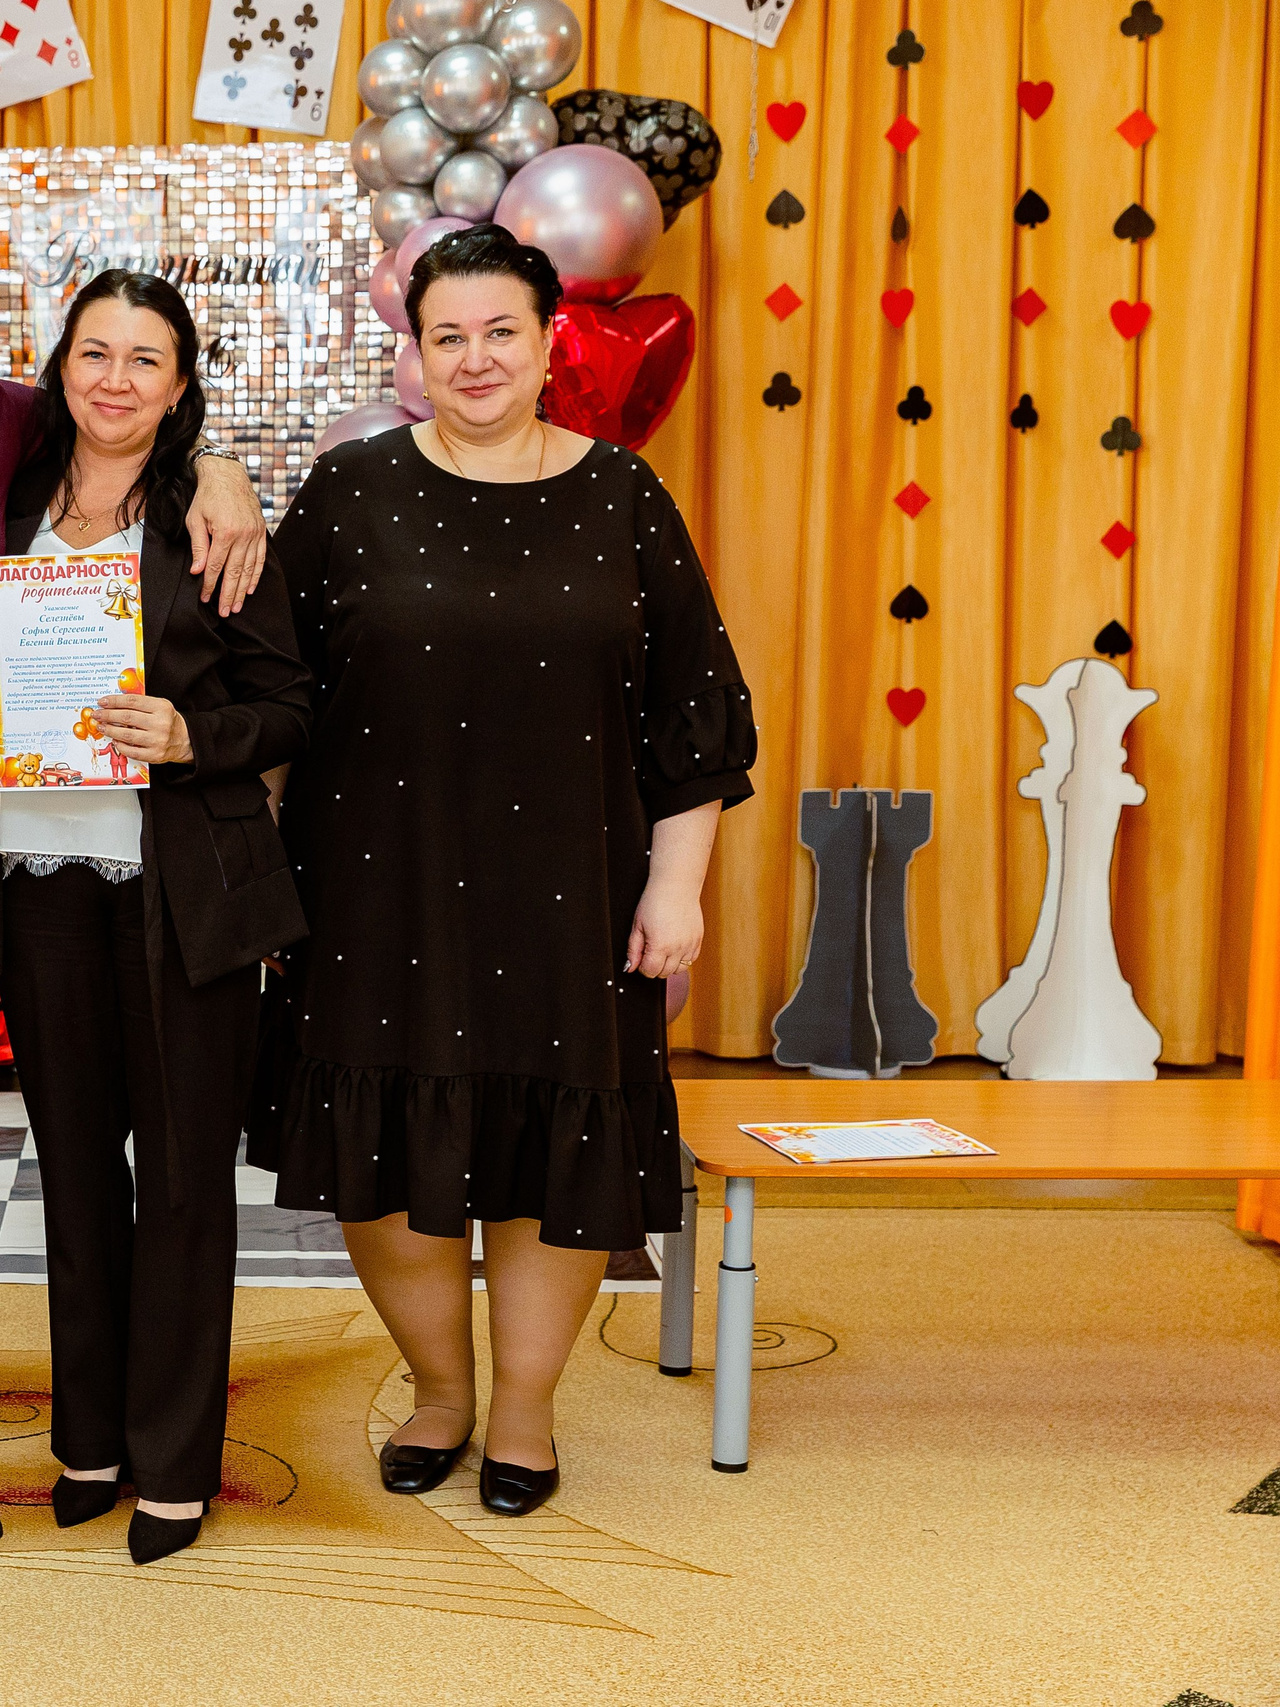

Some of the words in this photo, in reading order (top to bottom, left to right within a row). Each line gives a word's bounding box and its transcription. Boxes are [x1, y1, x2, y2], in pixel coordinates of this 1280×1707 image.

[67, 49, 81, 69] 8
[20, 585, 102, 604] родителям
[39, 613, 85, 623] Селезнёвы
[21, 626, 50, 637] Софья
[52, 624, 96, 636] Сергеевна
[19, 637, 55, 647] Евгений
[56, 636, 108, 646] Васильевич
